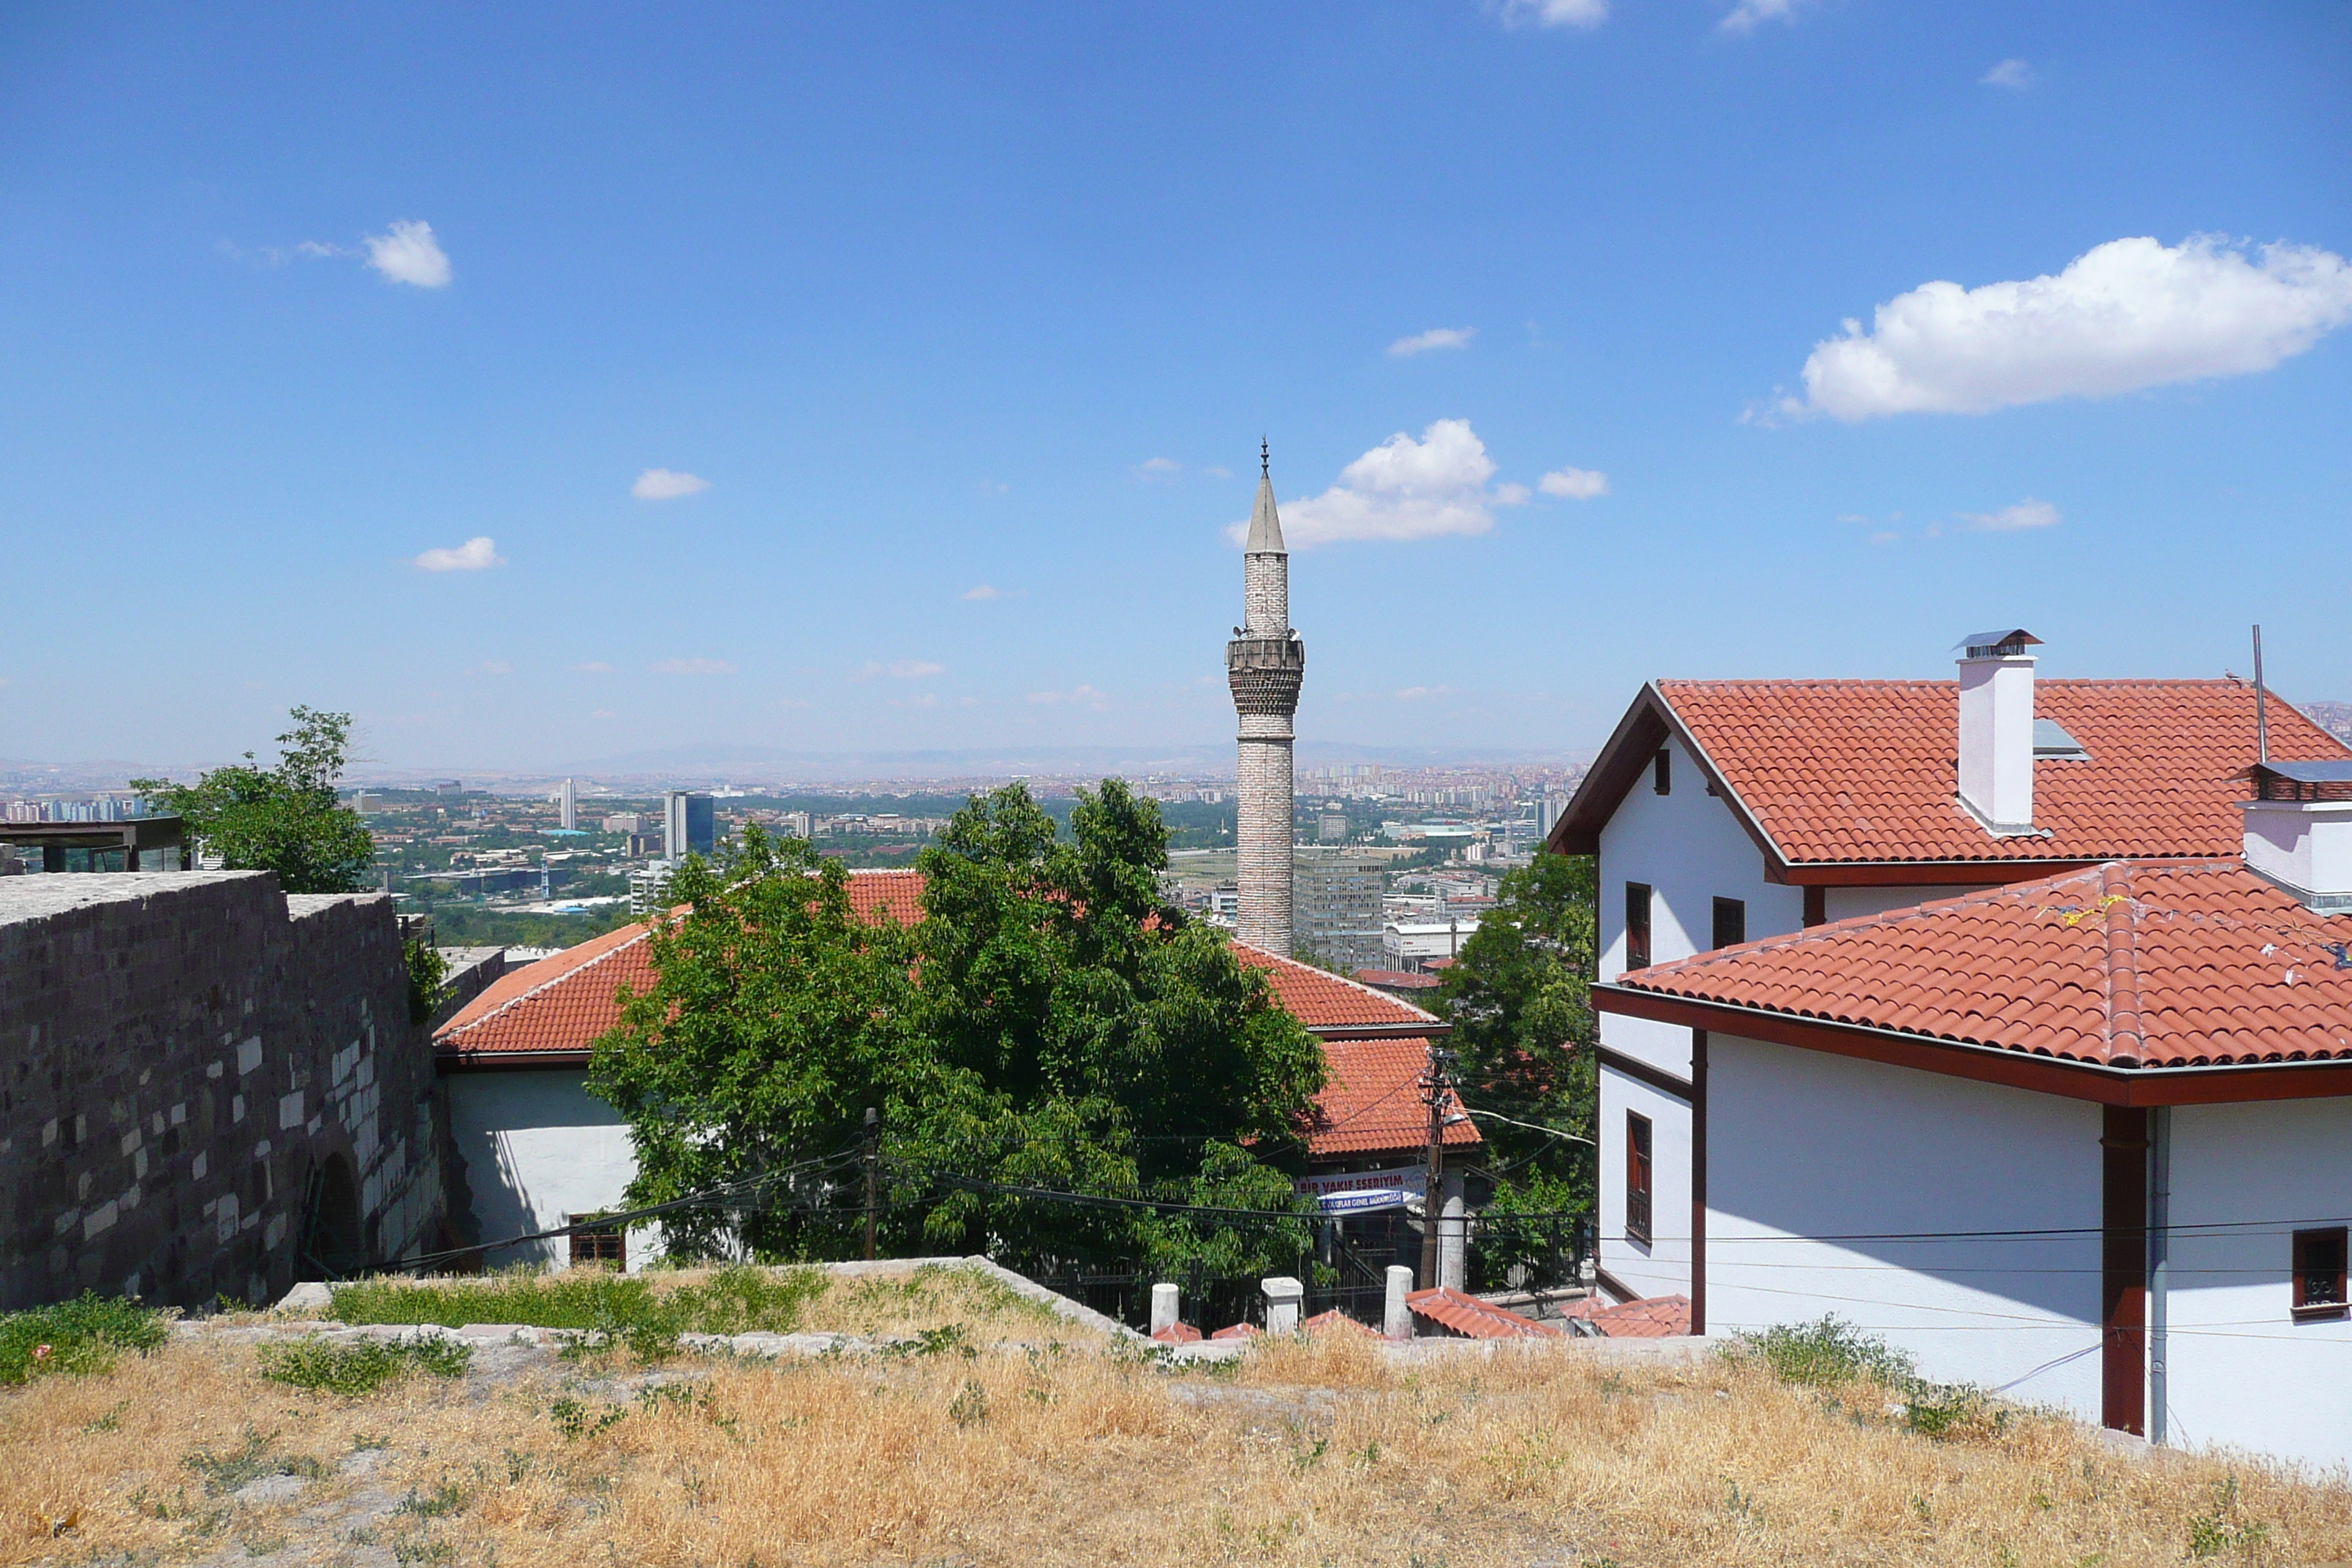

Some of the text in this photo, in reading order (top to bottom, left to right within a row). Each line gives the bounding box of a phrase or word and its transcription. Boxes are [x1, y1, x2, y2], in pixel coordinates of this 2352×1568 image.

[1322, 1180, 1354, 1193] VAKIF
[1356, 1172, 1403, 1190] ESERİYİM
[1352, 1198, 1368, 1207] GENEL
